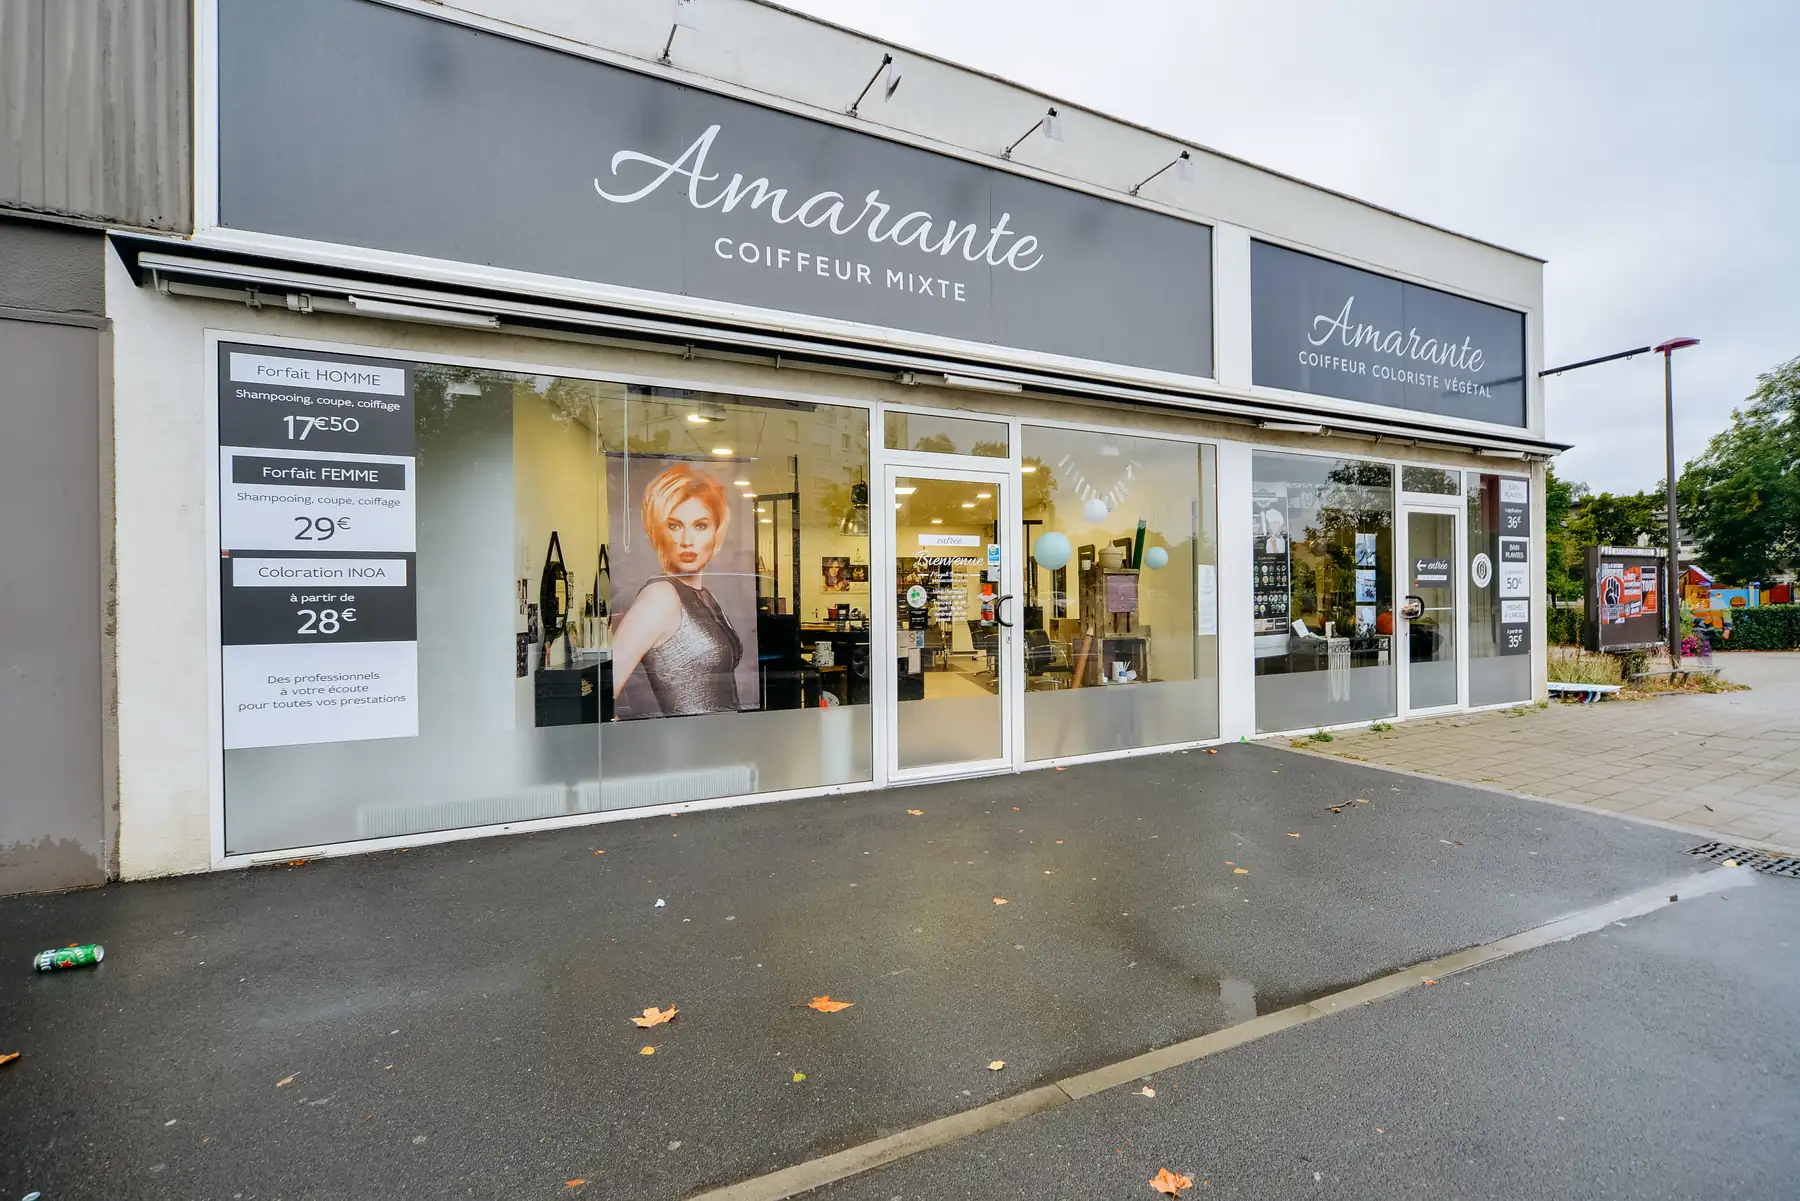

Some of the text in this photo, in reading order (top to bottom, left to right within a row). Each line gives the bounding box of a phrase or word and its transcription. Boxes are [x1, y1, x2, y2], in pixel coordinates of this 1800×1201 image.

[593, 124, 1044, 272] Amarante
[714, 237, 966, 302] COIFFEUR MIXTE
[1308, 296, 1485, 372] Amarante
[257, 365, 380, 386] Forfait HOMME
[1298, 351, 1492, 398] COIFFEUR COLORISTE VÉGÉTAL
[236, 389, 400, 413] Shampooing, coupe, coiffage
[283, 415, 360, 440] 17€50
[263, 467, 378, 482] Forfait FEMME
[237, 492, 401, 508] Shampooing, coupe, coiffage
[294, 516, 351, 541] 29€
[1507, 516, 1522, 528] 36€
[915, 550, 985, 567] Bienvenue
[1428, 560, 1448, 570] entrée
[258, 566, 386, 578] Coloration INOA
[290, 593, 355, 604] à partir de
[297, 608, 357, 634] 28€
[1508, 635, 1523, 648] 35€
[268, 672, 380, 685] Des professionnels
[280, 685, 369, 696] à votre écoute
[238, 694, 407, 712] pour toutes vos prestations
